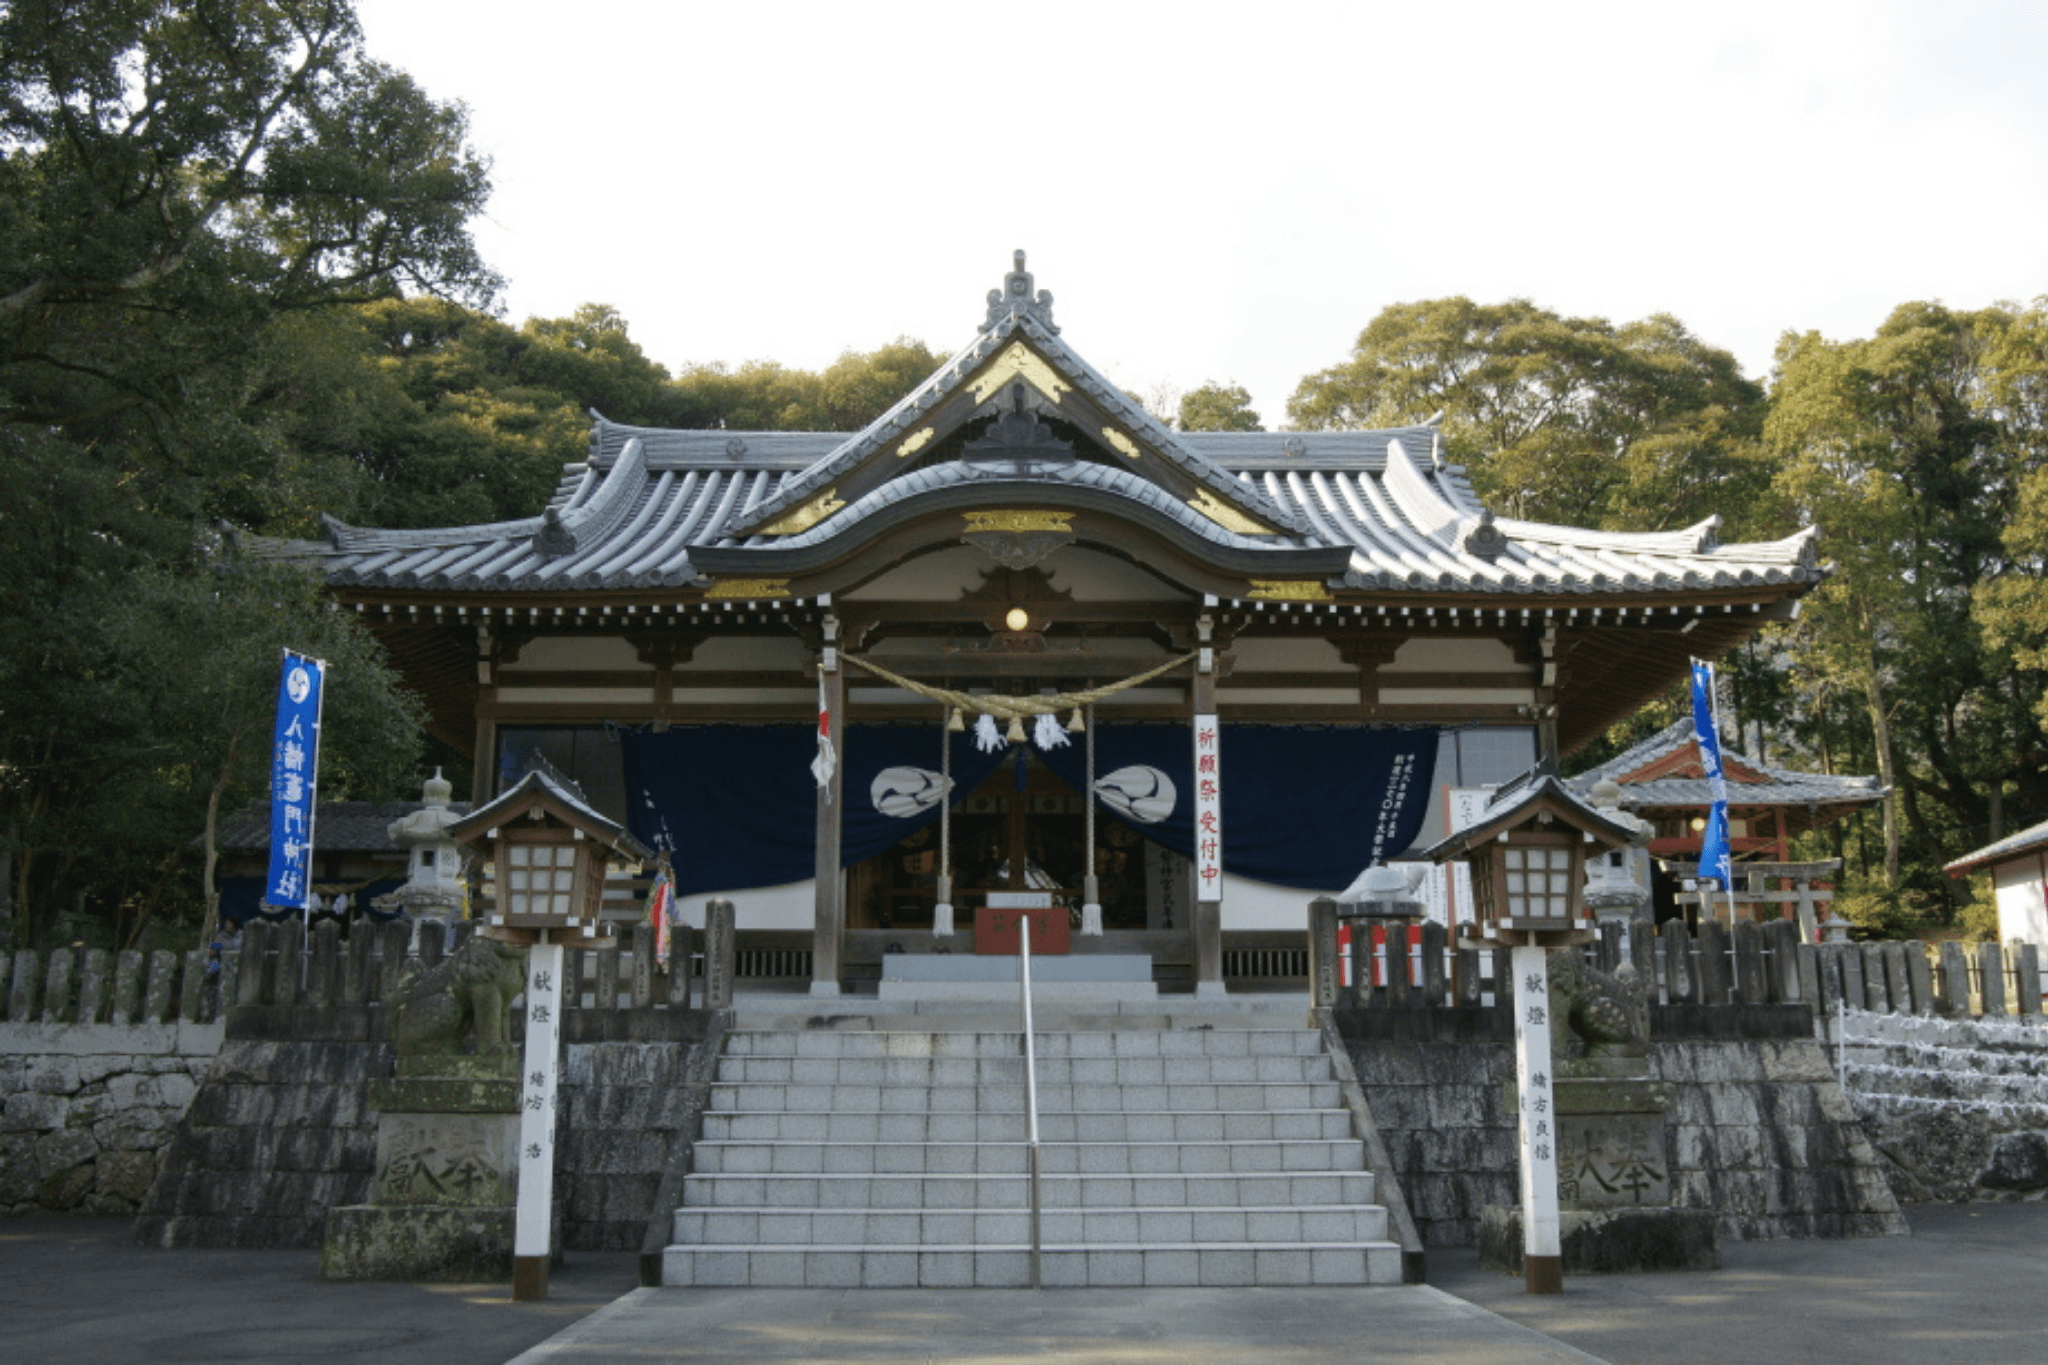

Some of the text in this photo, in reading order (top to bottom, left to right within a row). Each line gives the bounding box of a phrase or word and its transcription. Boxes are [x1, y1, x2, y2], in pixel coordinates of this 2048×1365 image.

[1198, 728, 1219, 887] 祈願祭受付中
